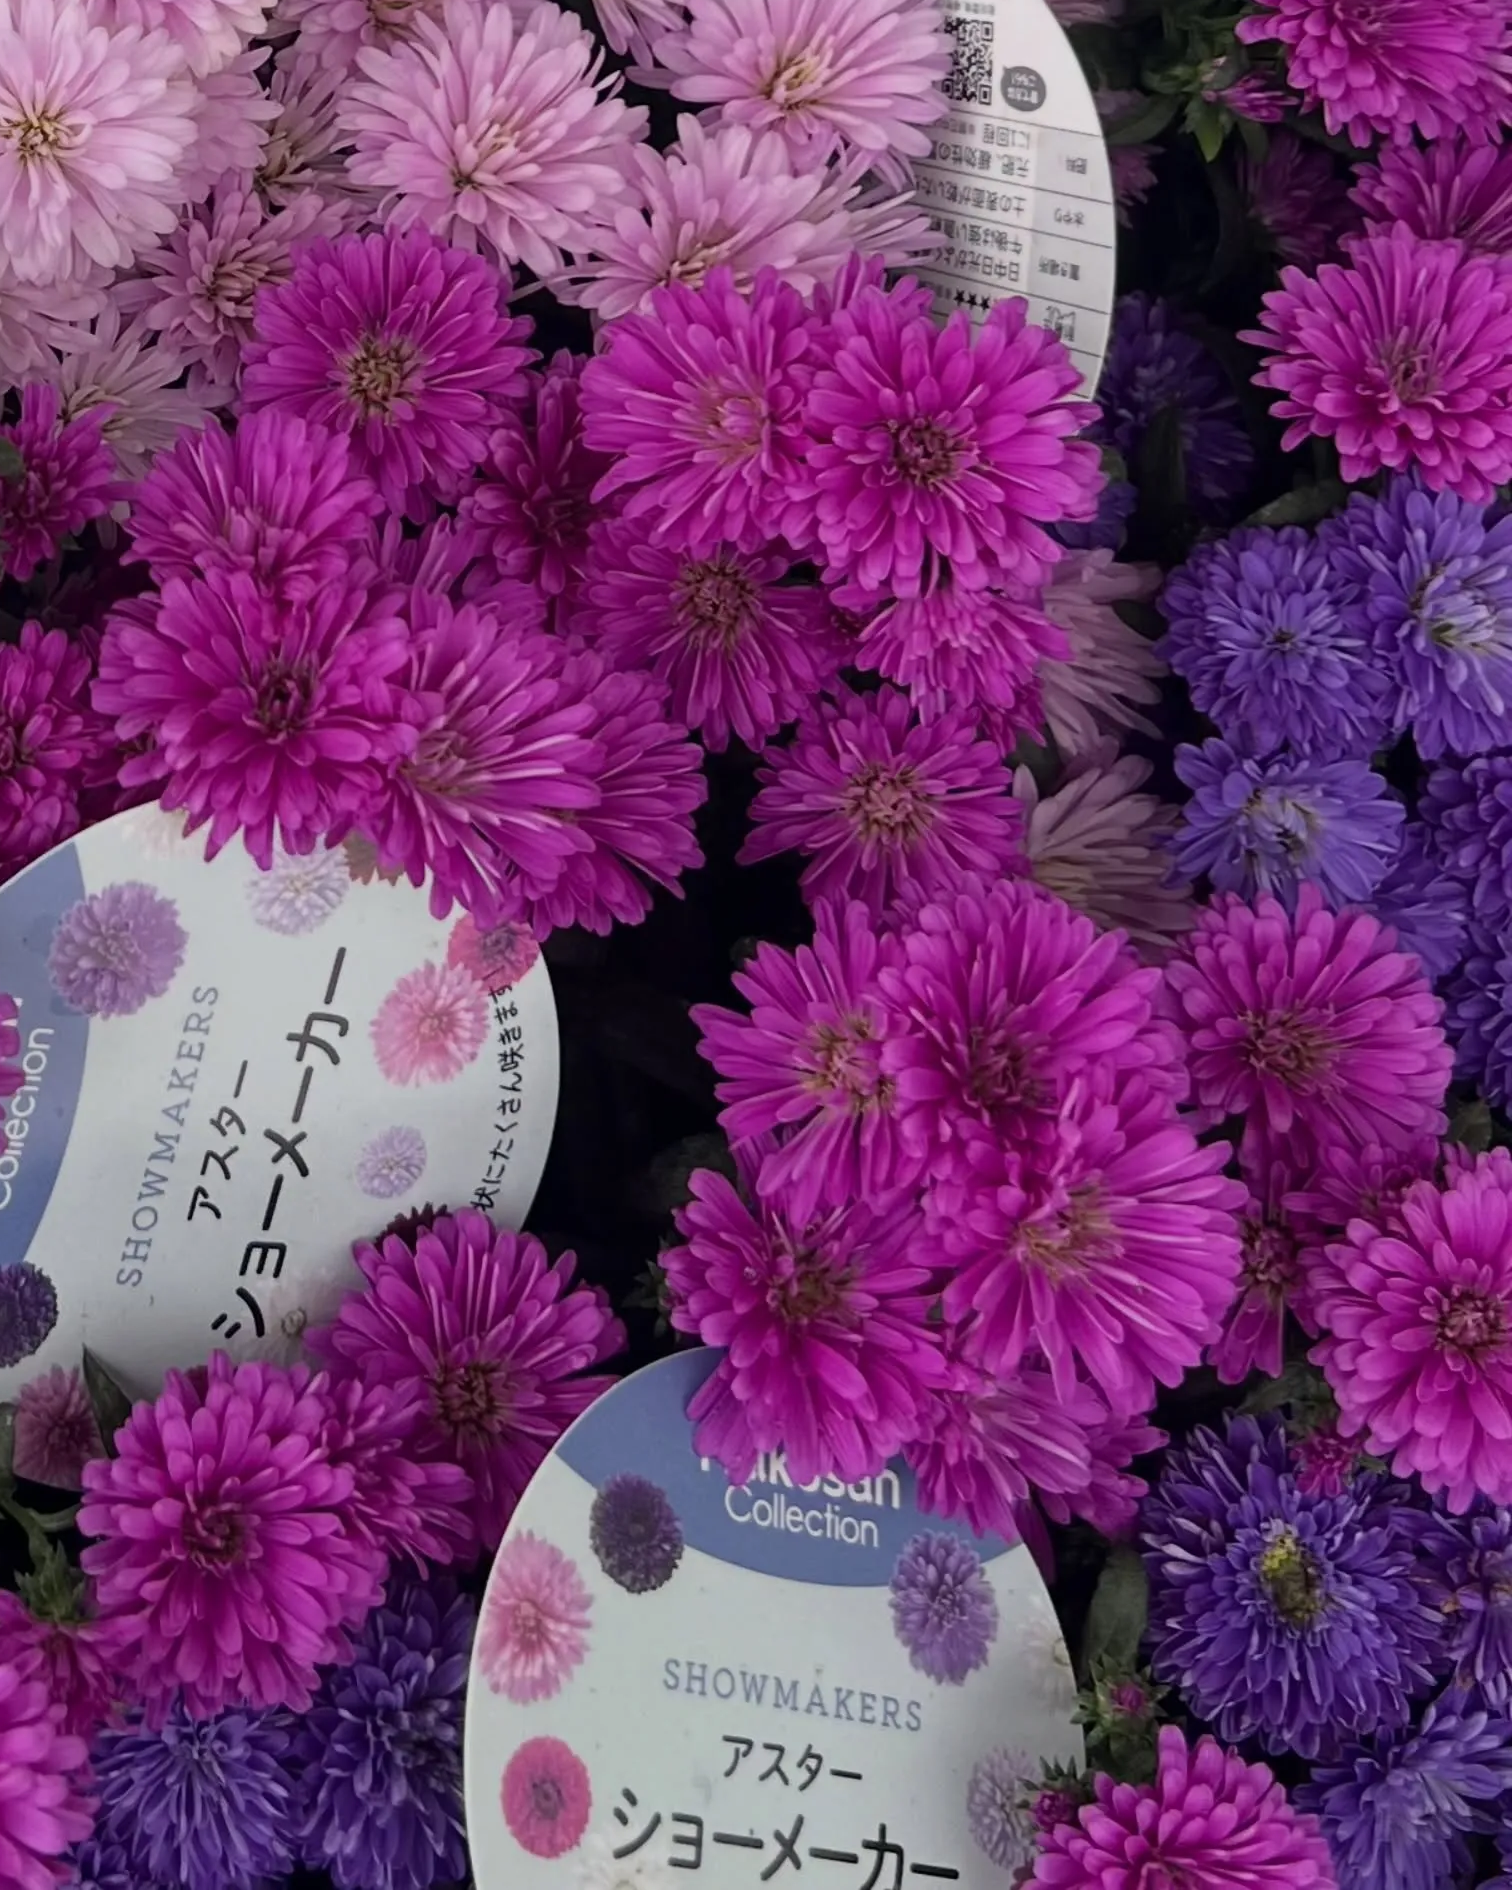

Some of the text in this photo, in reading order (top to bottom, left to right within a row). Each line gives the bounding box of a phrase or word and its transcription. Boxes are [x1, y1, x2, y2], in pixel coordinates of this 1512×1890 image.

[116, 984, 219, 1288] SHOWMAKERS
[187, 1060, 249, 1222] アスター
[210, 946, 350, 1340] ショーメーカー
[724, 1485, 880, 1548] Collection
[662, 1659, 923, 1732] SHOWMAKERS
[722, 1734, 863, 1791] アスター
[612, 1788, 960, 1890] ショーメーカー
